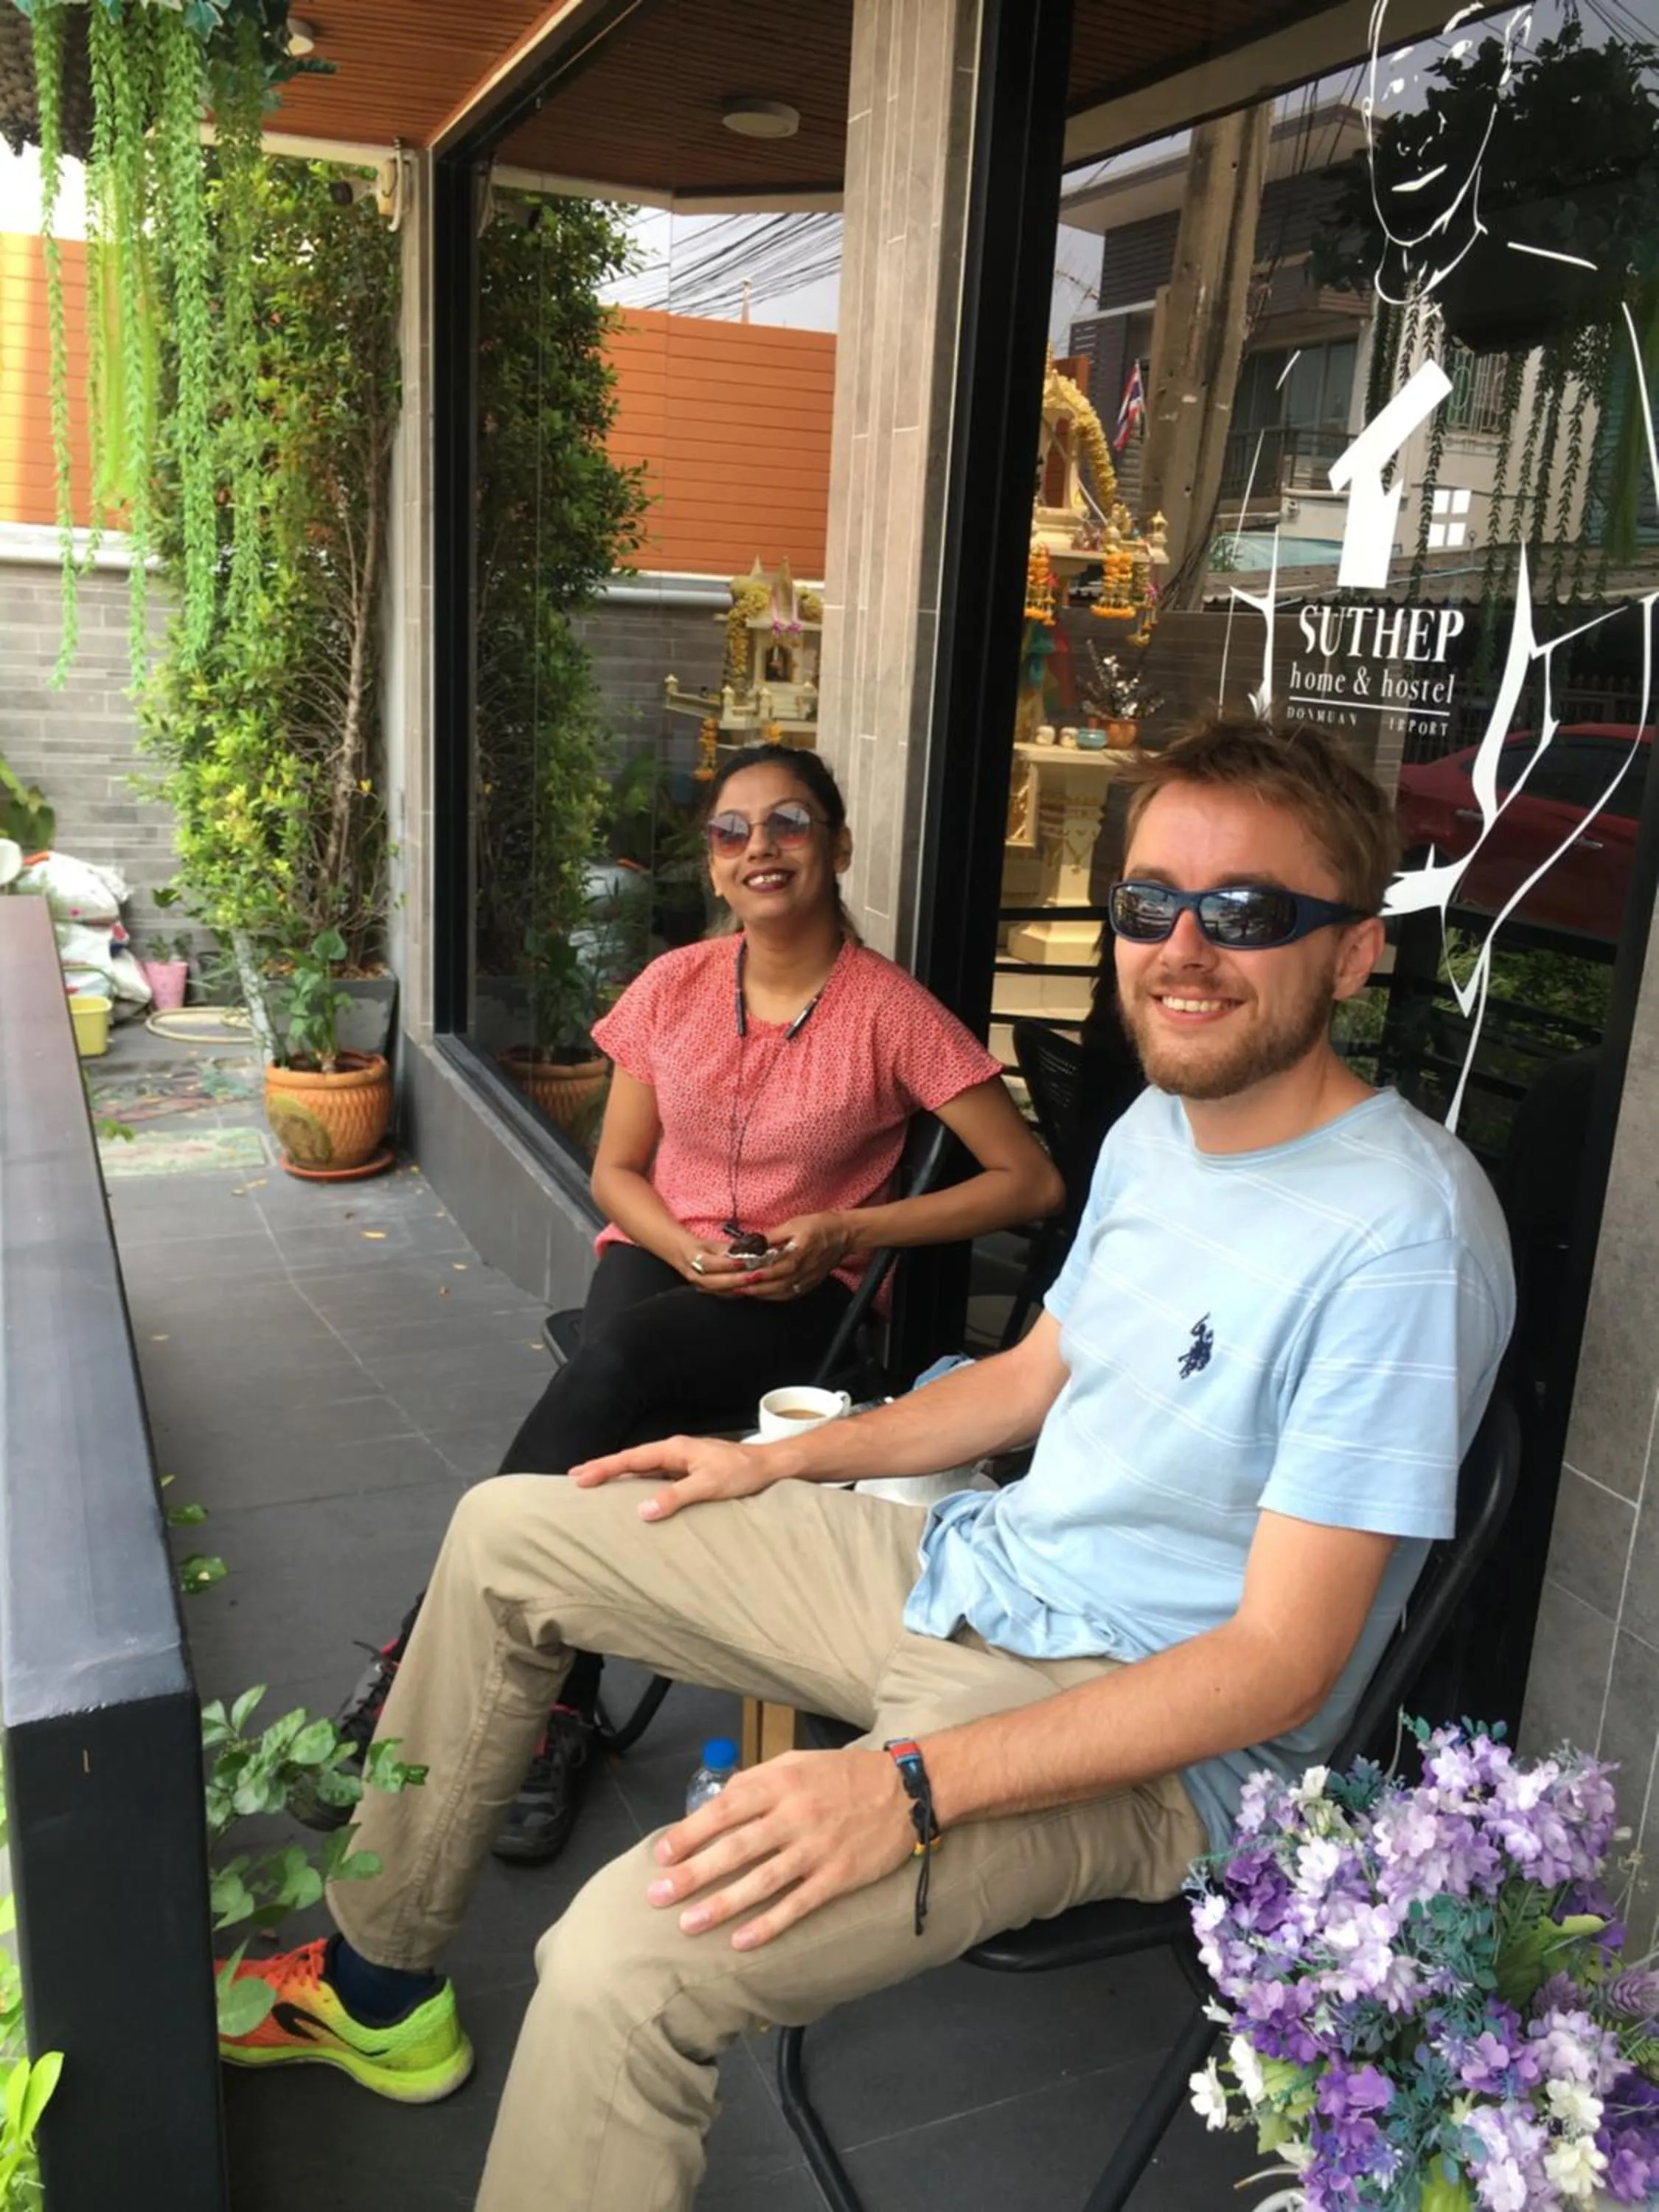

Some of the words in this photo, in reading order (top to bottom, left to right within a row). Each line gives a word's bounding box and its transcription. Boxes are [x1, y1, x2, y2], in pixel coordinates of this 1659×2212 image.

[1299, 605, 1465, 662] SUTHEP
[1290, 661, 1346, 694] home
[1353, 666, 1371, 696] &
[1380, 669, 1455, 704] hostel
